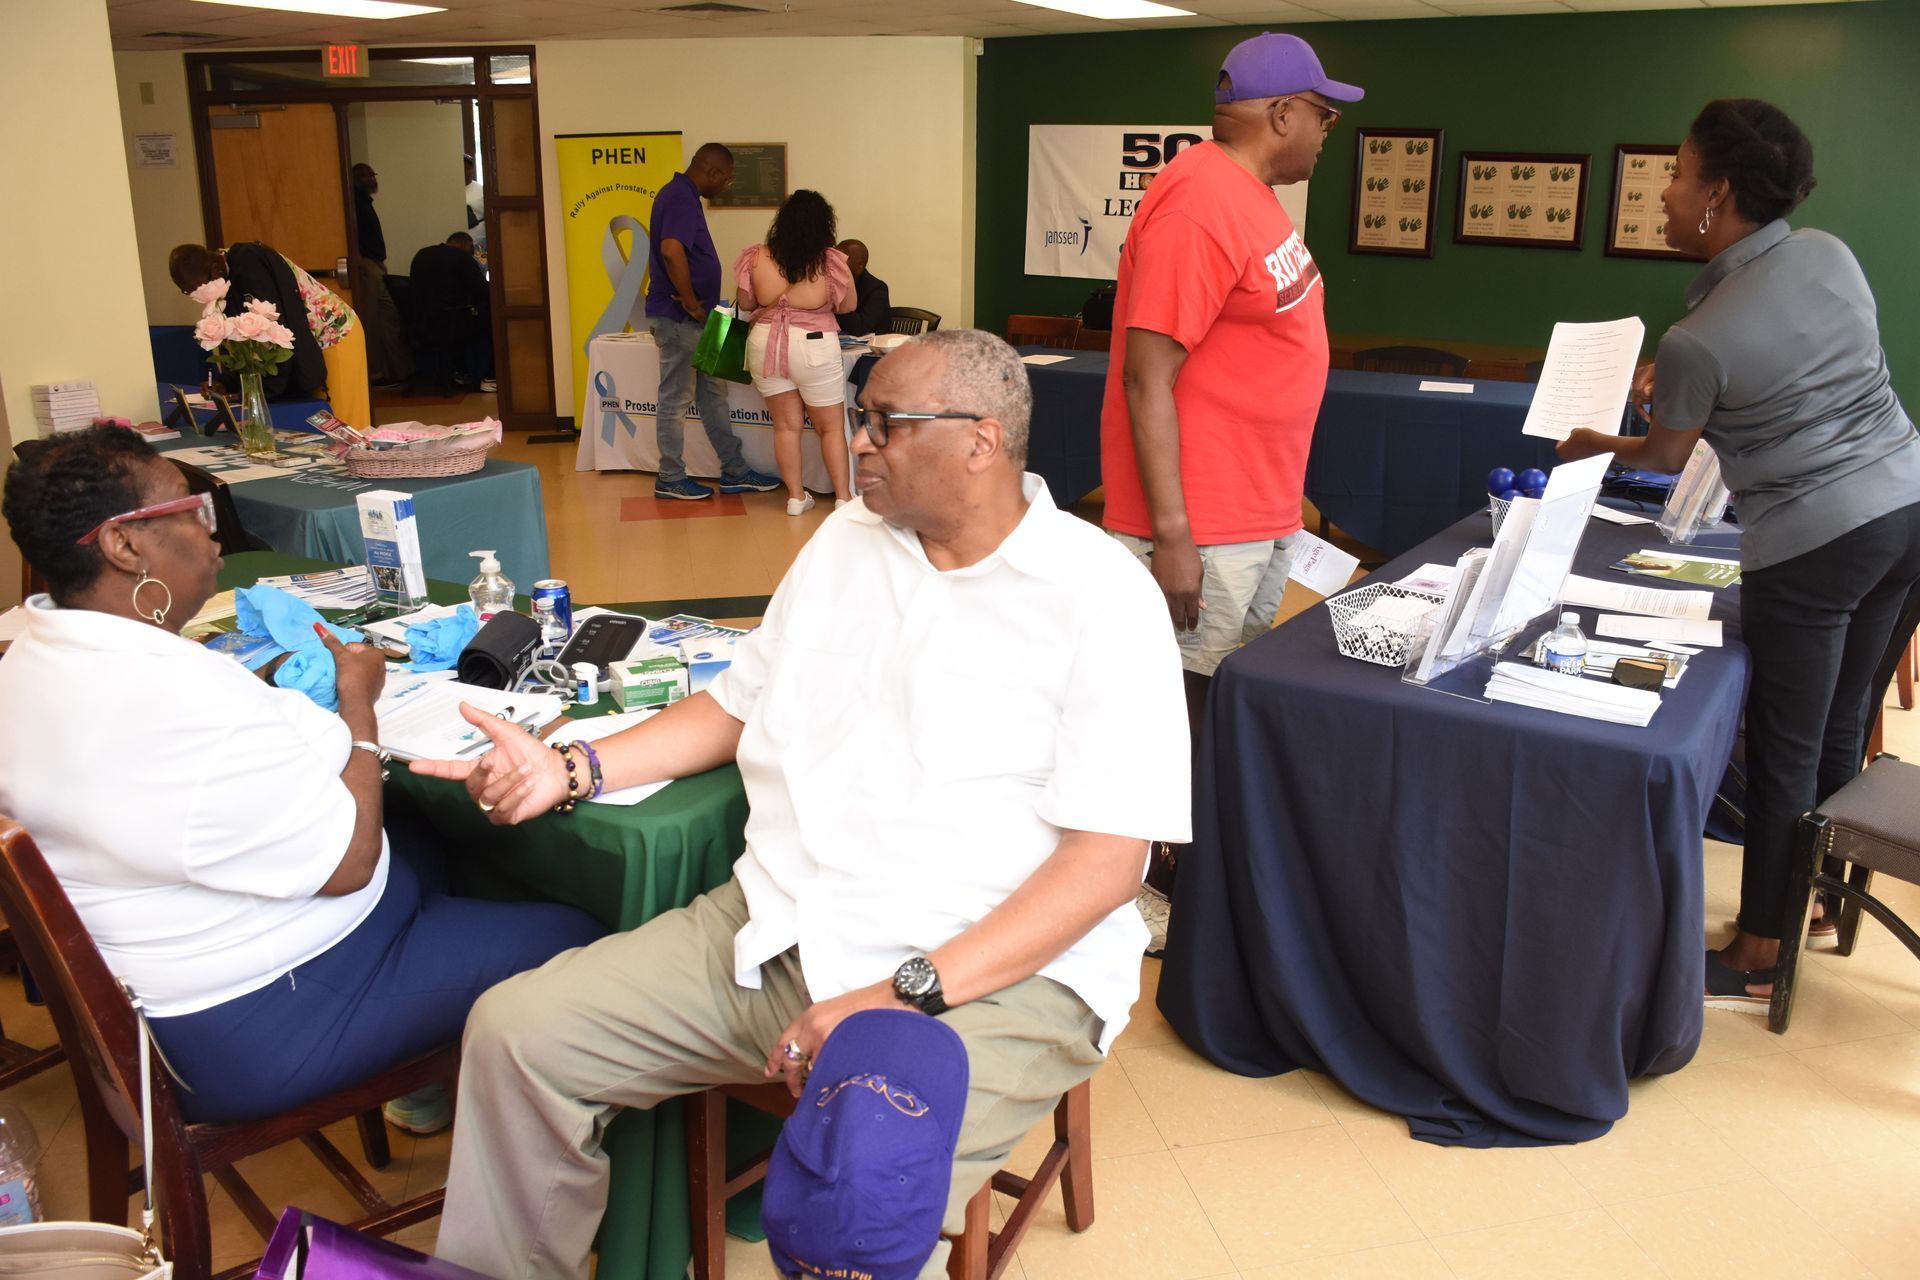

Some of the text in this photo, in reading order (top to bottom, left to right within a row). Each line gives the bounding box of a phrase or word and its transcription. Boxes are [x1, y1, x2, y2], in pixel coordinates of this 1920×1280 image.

[328, 44, 357, 75] EXIT
[591, 147, 646, 165] PHEN
[570, 199, 586, 219] Rally
[585, 184, 614, 201] Against
[615, 183, 648, 195] Prostate
[602, 400, 620, 408] PHEN
